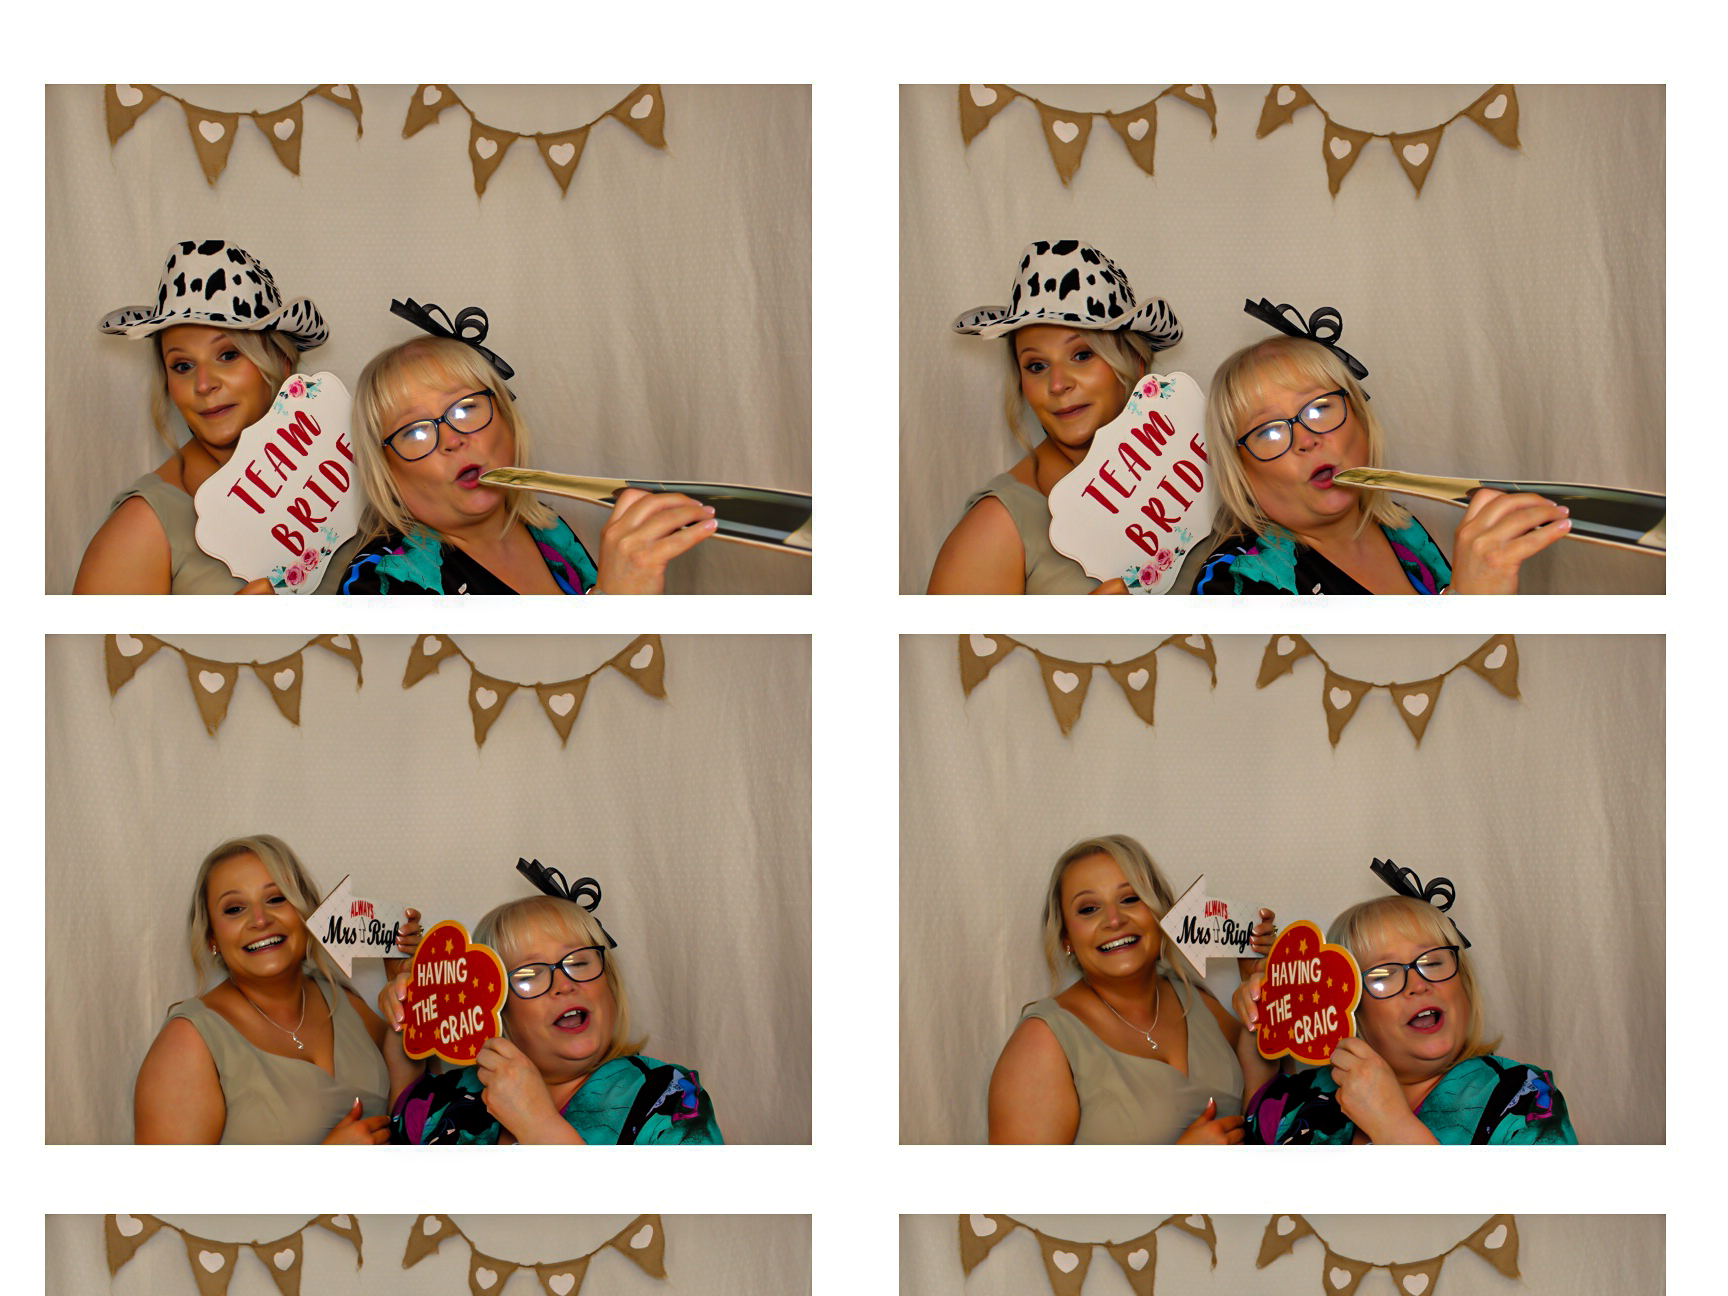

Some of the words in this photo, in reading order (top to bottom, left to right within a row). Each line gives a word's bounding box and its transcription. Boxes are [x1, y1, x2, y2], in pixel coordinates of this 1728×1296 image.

[227, 410, 322, 514] TEAM
[1081, 410, 1176, 514] TEAM
[350, 900, 375, 919] ALWAYS
[1204, 900, 1229, 919] ALWAYS
[322, 915, 357, 945] Mrs
[1176, 915, 1211, 945] Mrs
[417, 957, 468, 987] HAVING
[1271, 957, 1322, 987] HAVING
[412, 993, 438, 1026] THE
[440, 1005, 484, 1044] CRAIC
[1266, 993, 1292, 1026] THE
[1294, 1005, 1338, 1044] CRAIC
